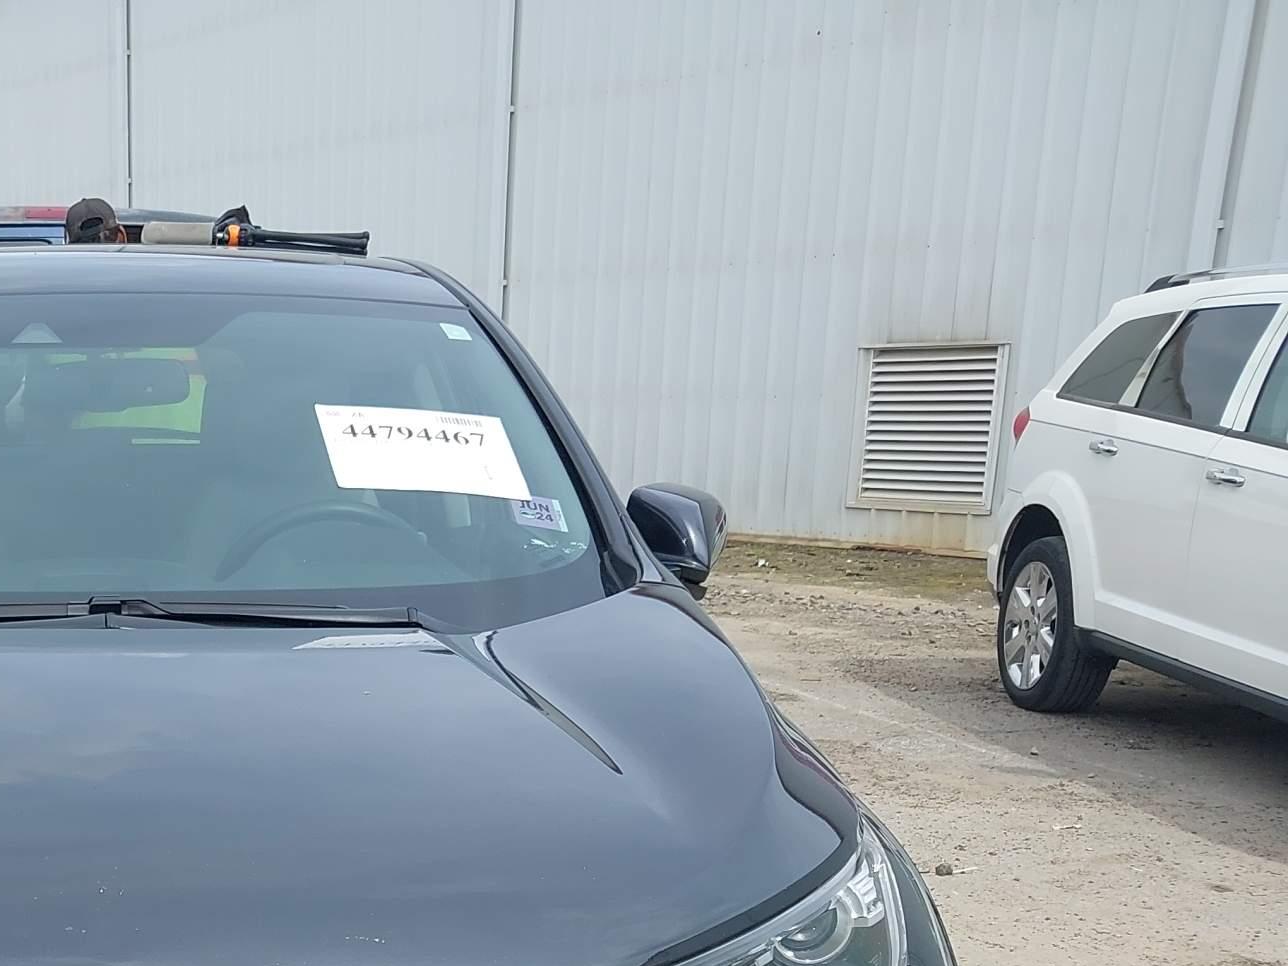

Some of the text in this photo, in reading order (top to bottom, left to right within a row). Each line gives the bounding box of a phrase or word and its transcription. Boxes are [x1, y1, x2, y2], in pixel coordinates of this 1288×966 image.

[342, 424, 484, 447] 44794467
[520, 501, 551, 513] JUN
[535, 511, 554, 522] 24
